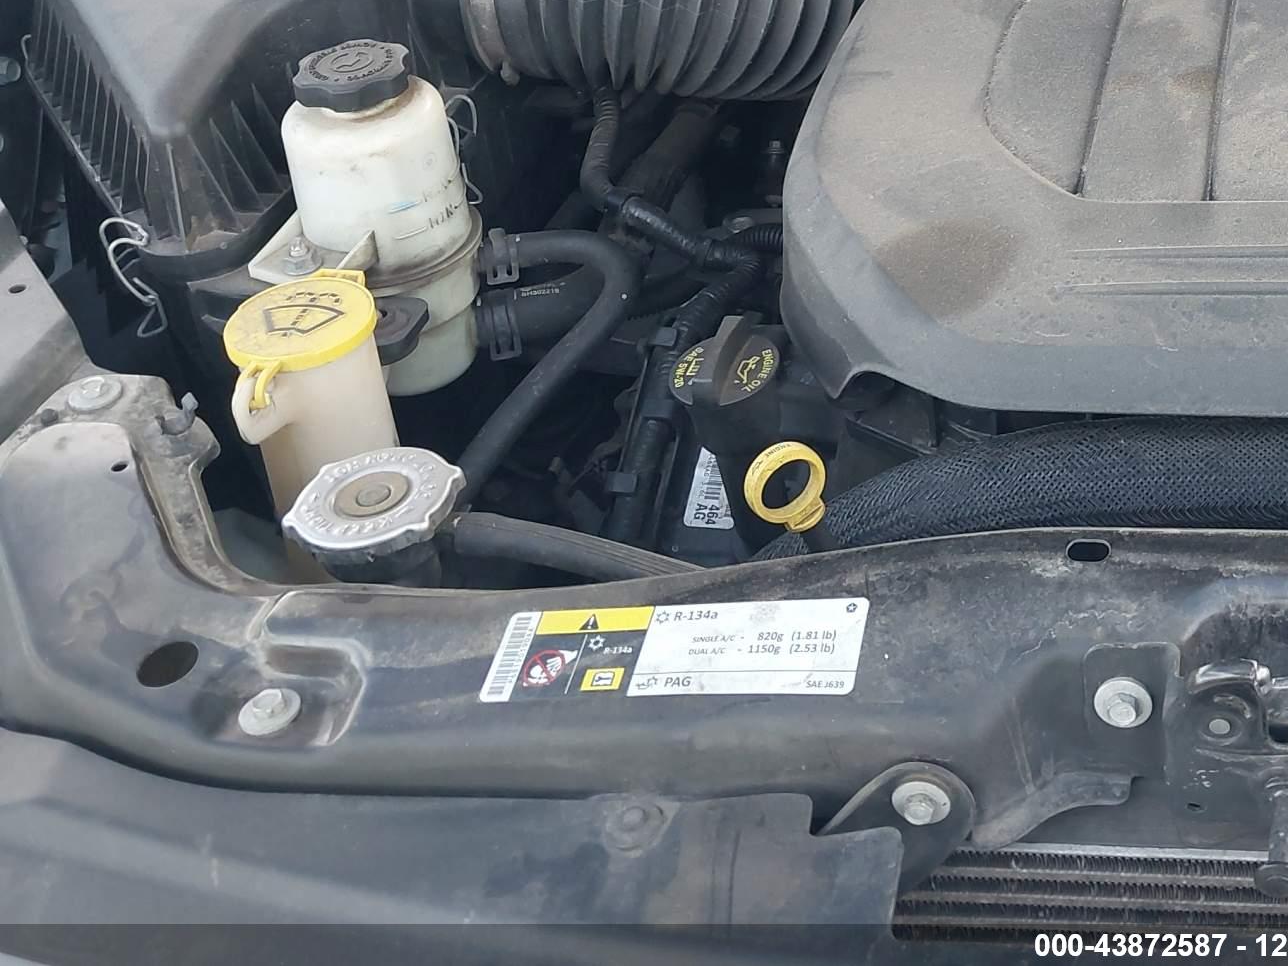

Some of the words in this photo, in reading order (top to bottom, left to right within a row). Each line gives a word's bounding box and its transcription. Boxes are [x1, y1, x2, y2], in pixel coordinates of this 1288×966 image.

[684, 346, 705, 362] SAE
[756, 348, 776, 380] ENGINE
[674, 361, 690, 389] 5W-20
[741, 379, 762, 393] OIL
[694, 503, 708, 521] AG
[705, 504, 721, 525] 464
[673, 610, 719, 622] R-134a
[757, 630, 784, 643] 820g
[791, 630, 819, 642] (1.81
[821, 629, 837, 641] lb)
[602, 645, 633, 655] R-134a
[747, 643, 781, 656] 1150g
[789, 643, 819, 654] (2.53
[821, 642, 835, 654] lb)
[664, 676, 691, 688] PAG
[805, 680, 822, 688] SAE
[824, 680, 845, 688] J639
